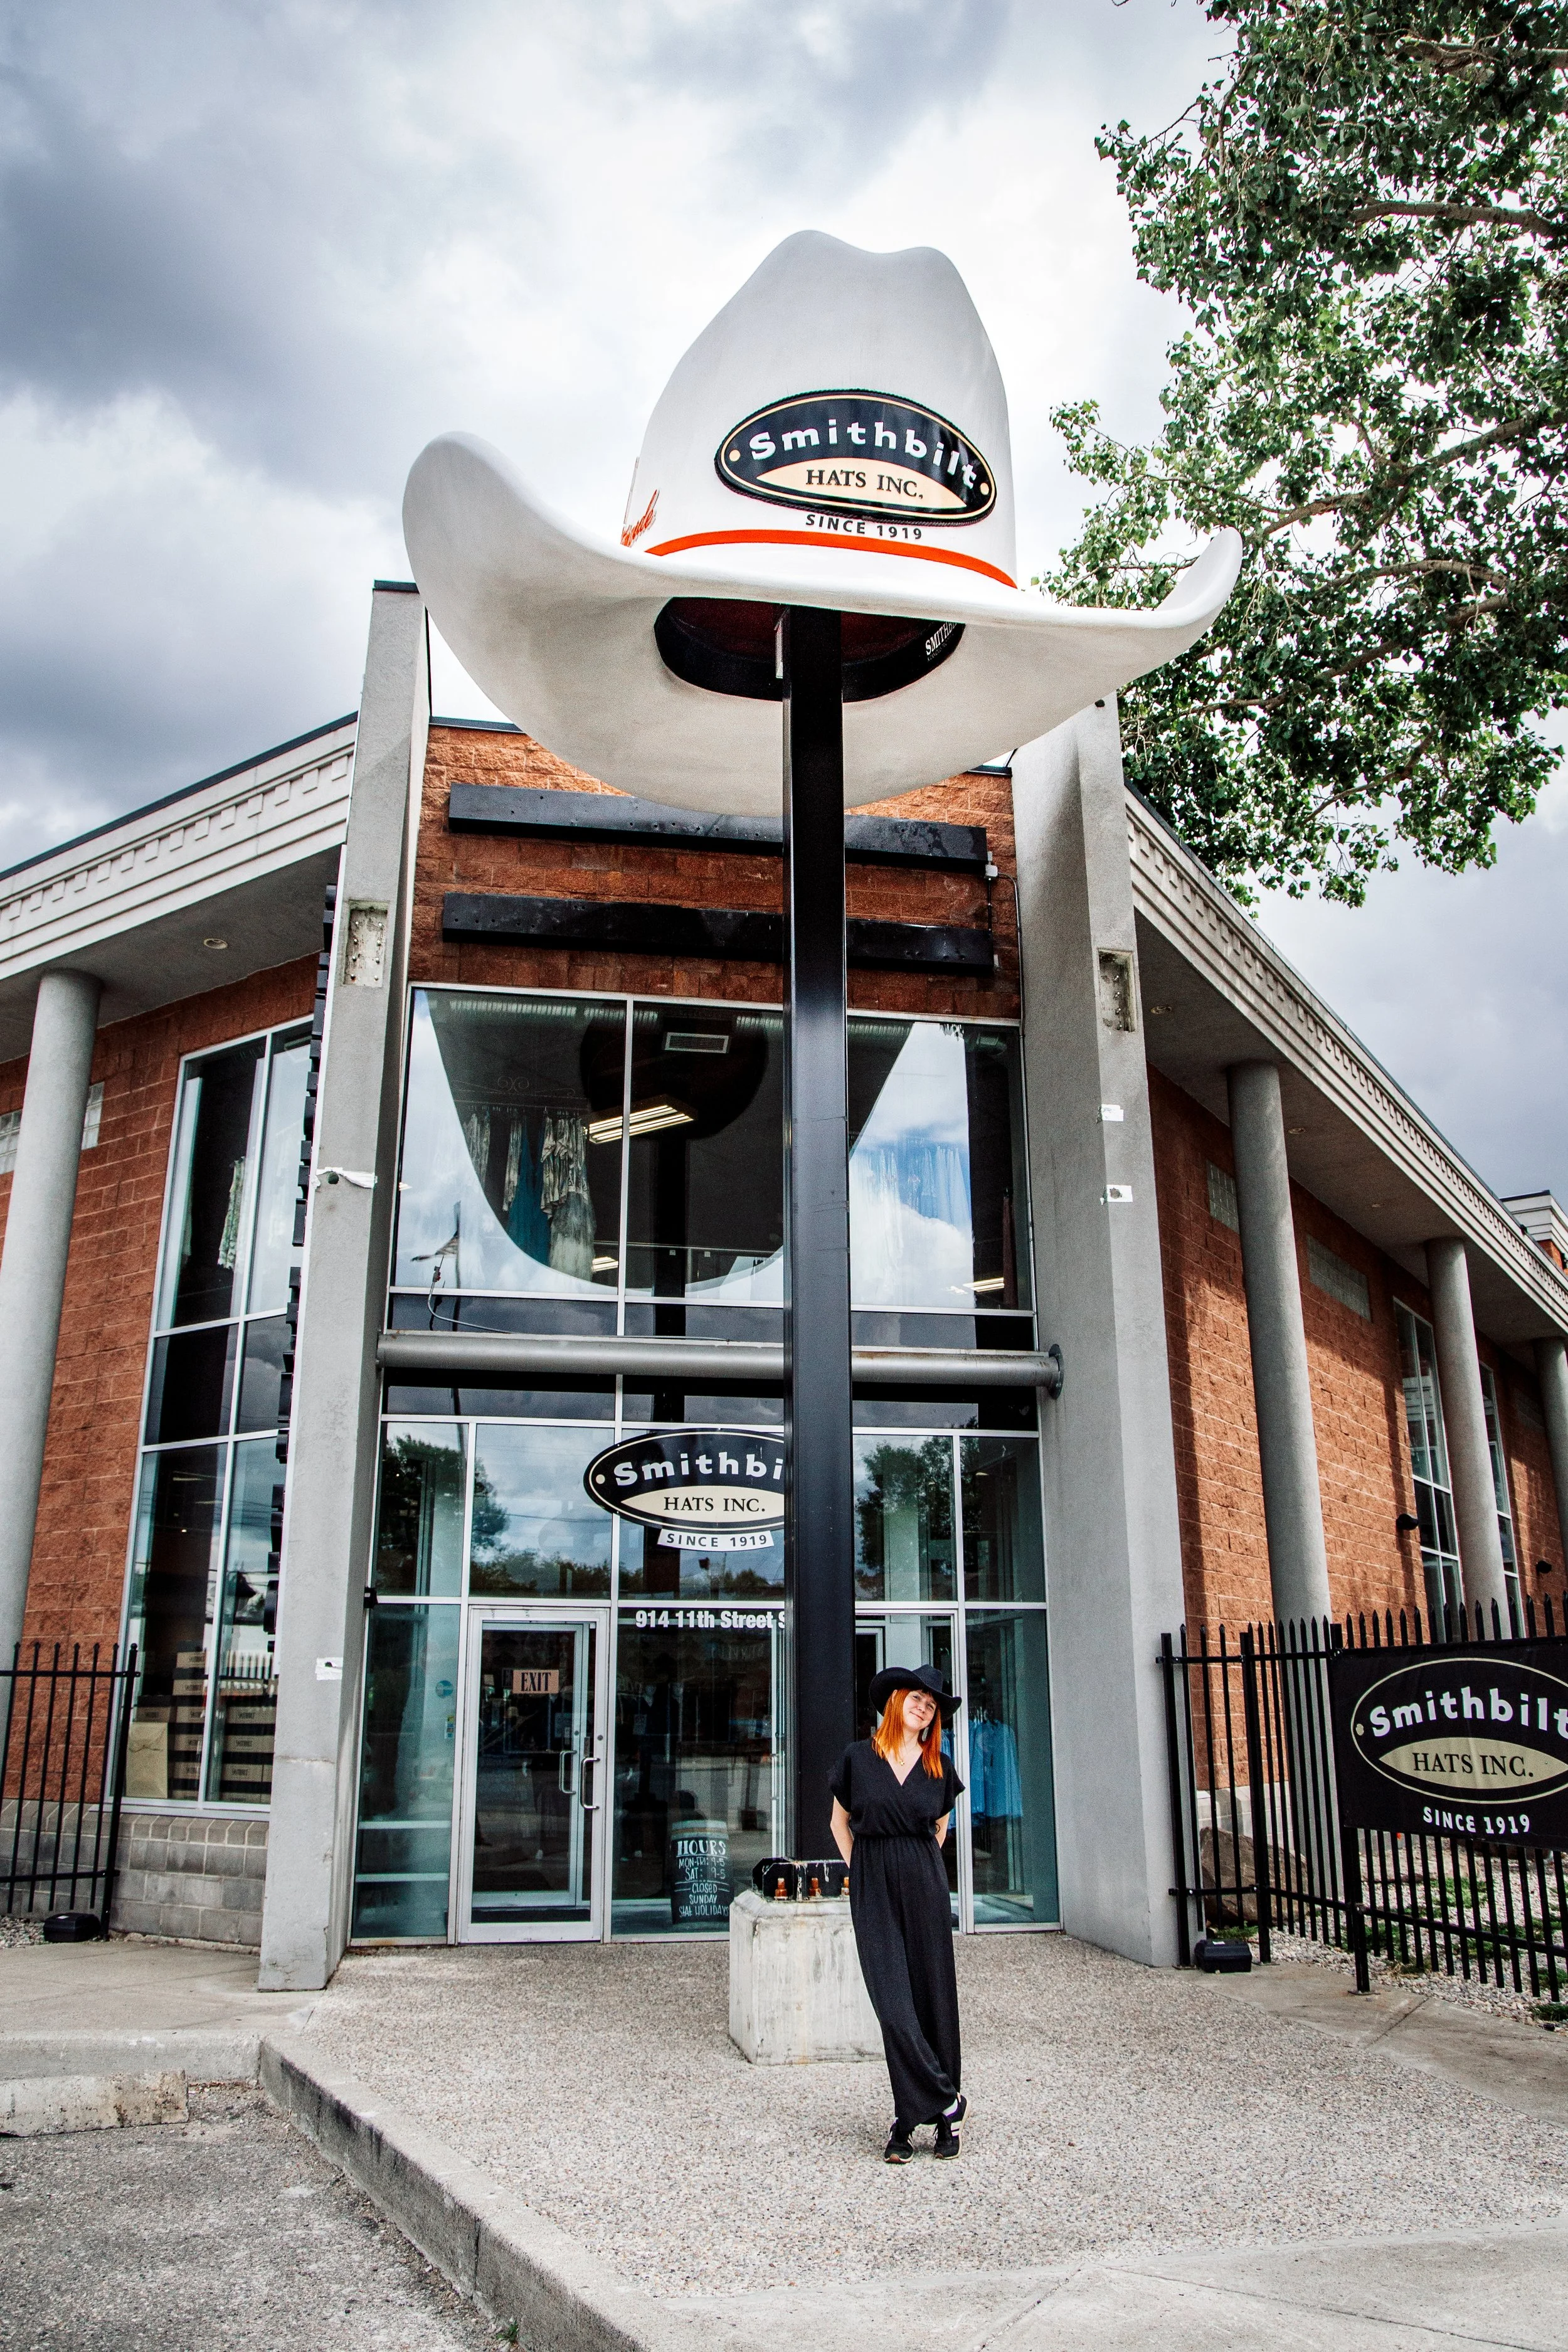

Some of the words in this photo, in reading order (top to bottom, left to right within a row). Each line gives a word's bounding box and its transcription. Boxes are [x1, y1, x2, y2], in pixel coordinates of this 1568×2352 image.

[749, 419, 977, 489] Smithbilt
[805, 469, 866, 488] HATS
[877, 474, 923, 499] INC.
[805, 514, 866, 534] SINCE
[877, 525, 923, 540] 1919
[613, 1451, 783, 1486] Smithbi
[664, 1496, 714, 1512] HATS
[723, 1498, 765, 1512] INC.
[667, 1533, 718, 1547] SINCE
[729, 1535, 767, 1547] 1919
[635, 1610, 669, 1628] 914
[675, 1610, 715, 1628] 11th
[721, 1611, 773, 1629] Street
[521, 1672, 551, 1692] EXIT
[1369, 1686, 1568, 1740] Smithbilt
[1412, 1752, 1473, 1774] HATS
[1480, 1755, 1534, 1777] INC.
[1423, 1806, 1476, 1833] SINCE
[1483, 1814, 1530, 1835] 1919
[677, 1840, 726, 1856] HOURS
[711, 1857, 725, 1867] 9-5
[711, 1867, 726, 1879] 9-5
[689, 1894, 718, 1905] SUNDAY
[695, 1905, 729, 1916] HOLIDAYS
